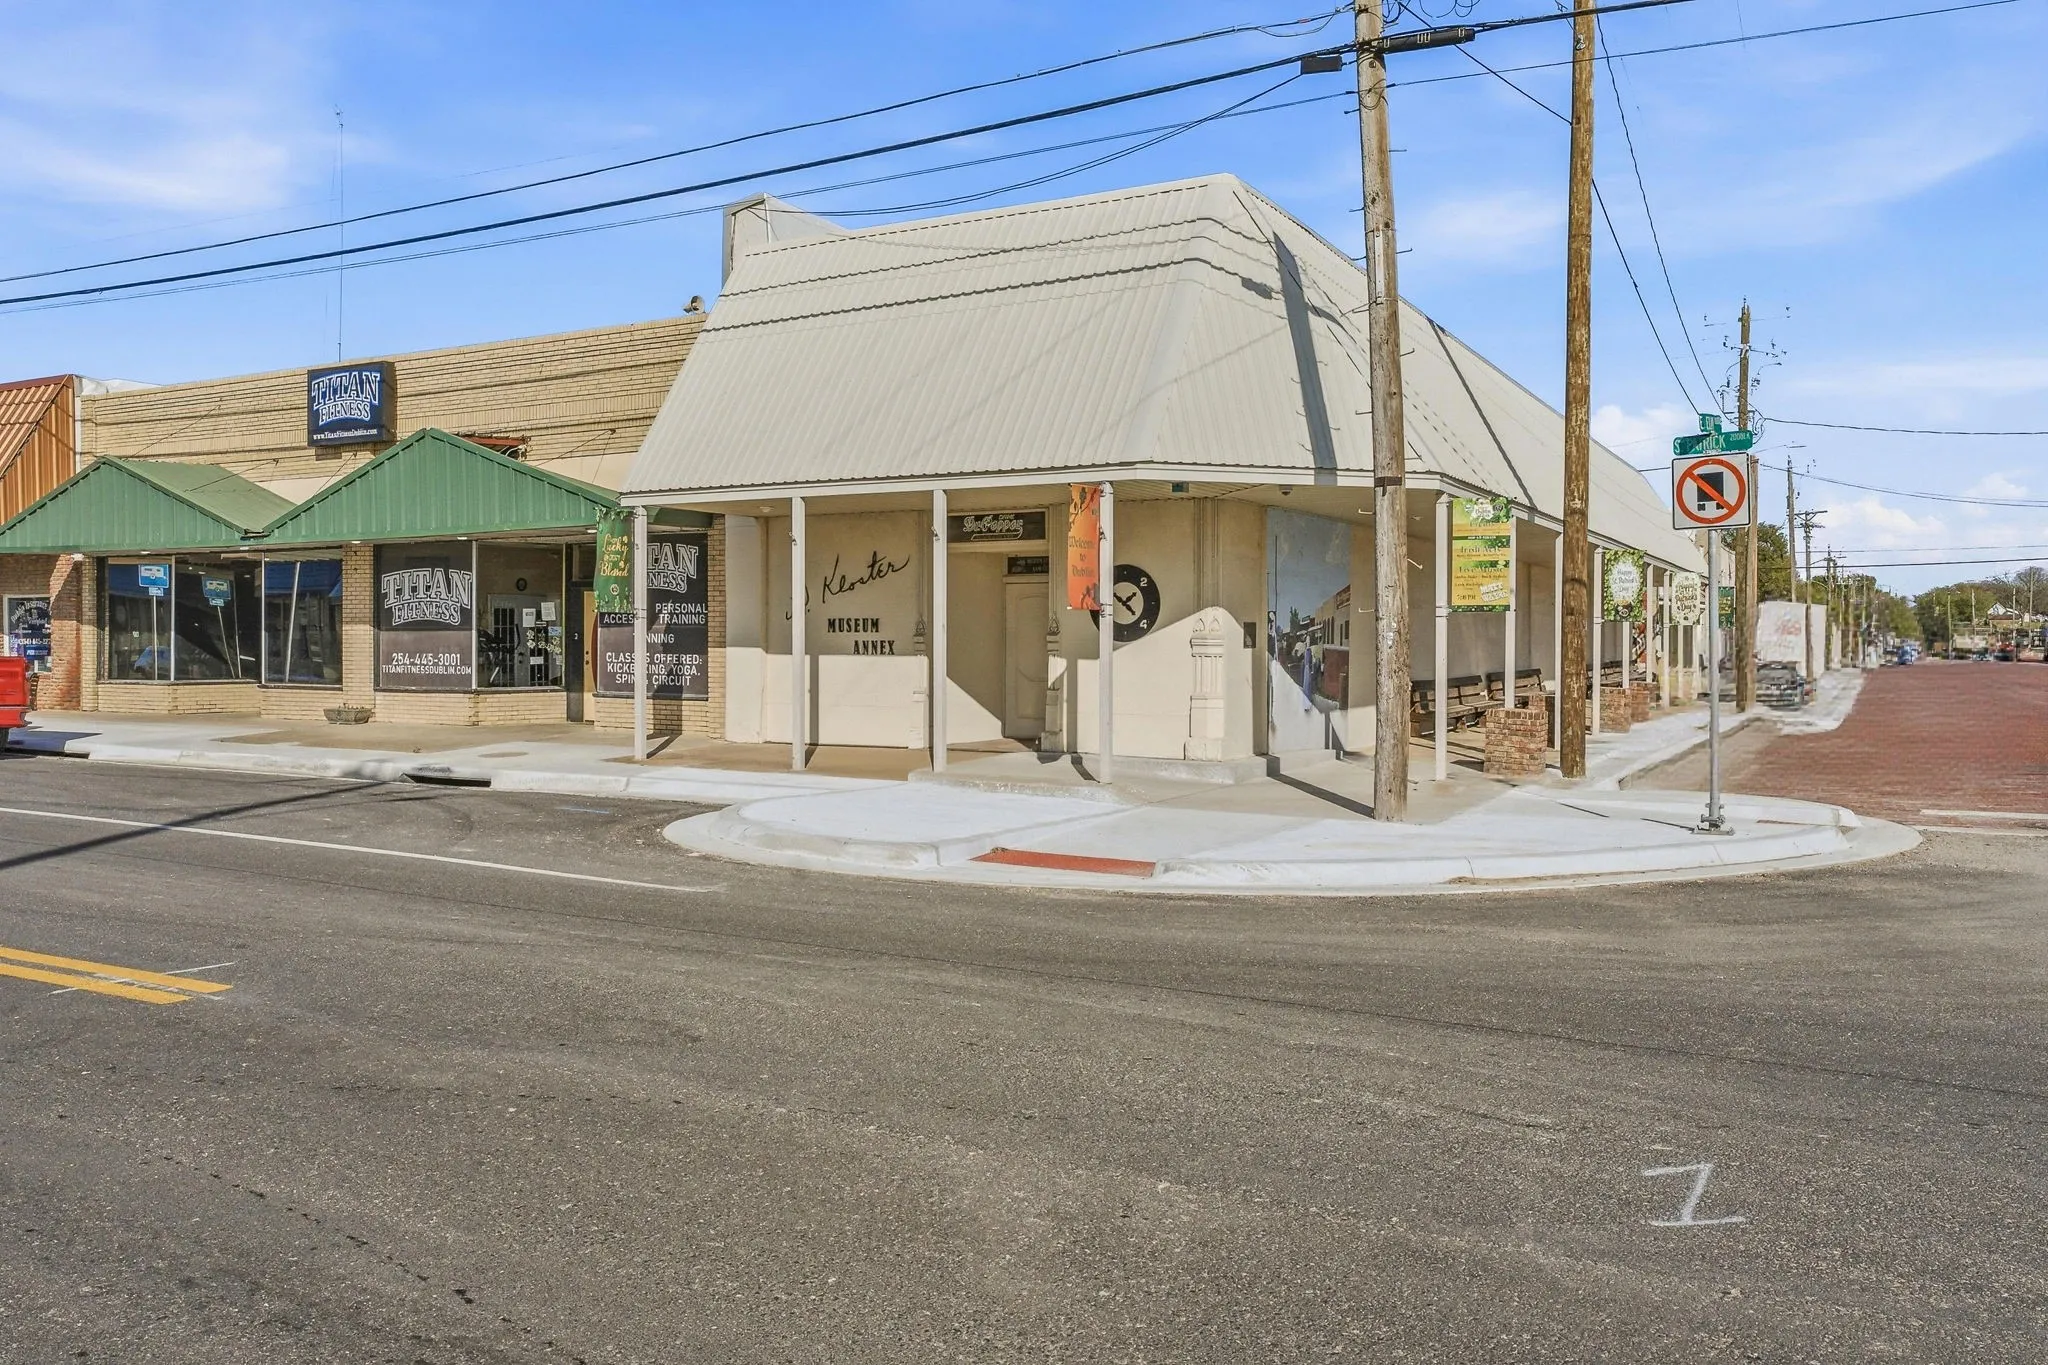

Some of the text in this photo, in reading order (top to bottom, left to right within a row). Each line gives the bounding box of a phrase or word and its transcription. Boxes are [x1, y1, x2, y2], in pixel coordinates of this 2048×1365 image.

[312, 371, 380, 411] TITAN
[319, 401, 371, 426] FITNESS
[602, 534, 629, 561] Lucky
[647, 543, 698, 579] TAN
[1079, 553, 1086, 562] to
[648, 571, 687, 593] NESS
[822, 551, 910, 604] Kloster
[1140, 577, 1148, 587] 2
[381, 568, 473, 609] TITAN
[392, 600, 461, 626] FITNESS
[655, 602, 708, 614] PERSONAL
[603, 613, 634, 624] ACCES
[658, 613, 706, 625] TRAINING
[1140, 620, 1147, 630] 4
[827, 618, 880, 633] MUSEUM
[633, 632, 675, 643] NNING
[853, 640, 895, 655] ANNEX
[391, 653, 461, 666] 254-445-3001
[606, 652, 702, 665] CLASSS OFFERED:
[381, 664, 472, 675] TITANFITNESSDUBLIN.COM
[607, 663, 700, 676] KICKBING, YOGA,
[652, 675, 691, 686] CIRCUIT
